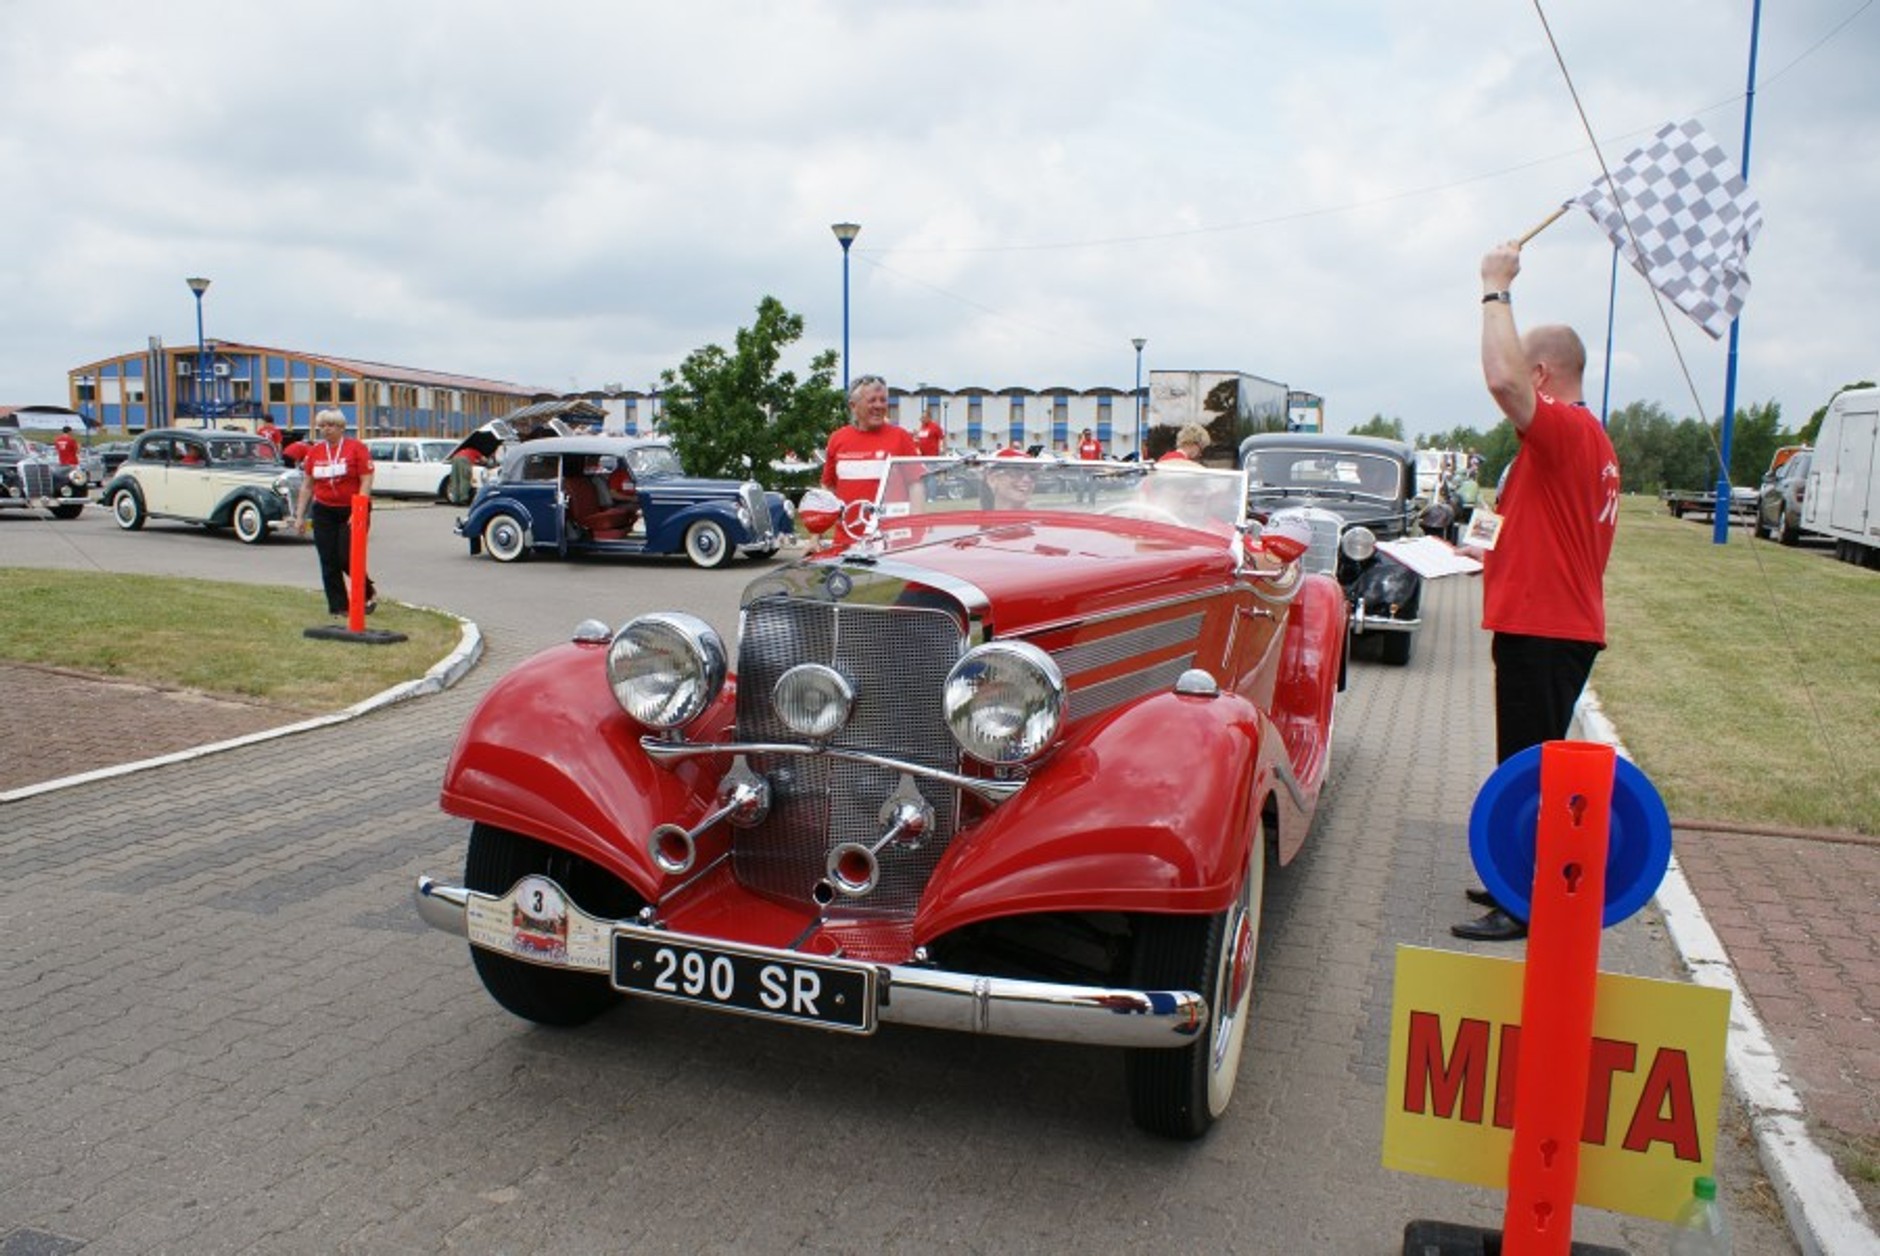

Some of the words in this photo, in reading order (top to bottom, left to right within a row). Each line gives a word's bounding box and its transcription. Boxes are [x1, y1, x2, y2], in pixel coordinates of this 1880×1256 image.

[532, 890, 543, 913] 3
[654, 948, 734, 1000] 290
[759, 964, 821, 1016] SR
